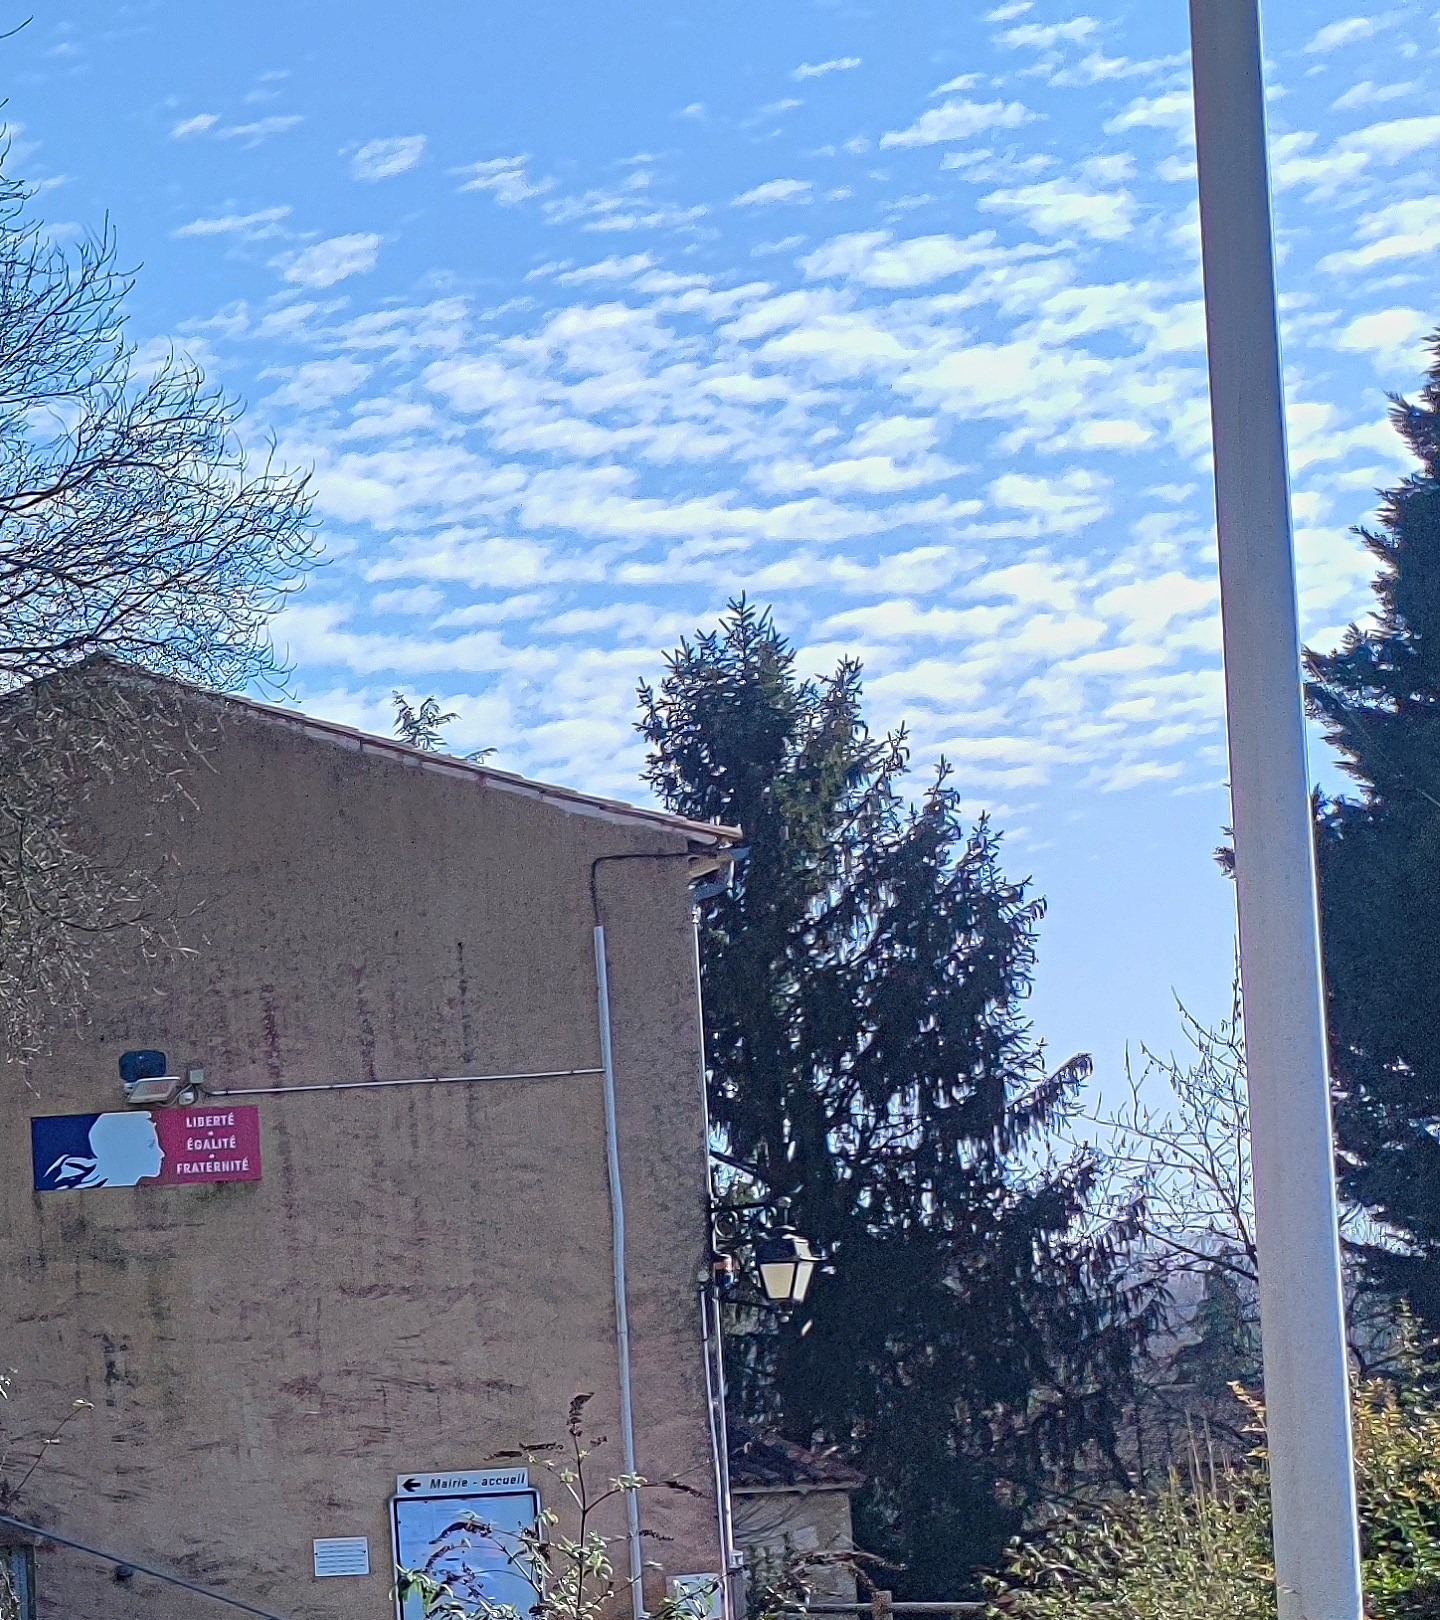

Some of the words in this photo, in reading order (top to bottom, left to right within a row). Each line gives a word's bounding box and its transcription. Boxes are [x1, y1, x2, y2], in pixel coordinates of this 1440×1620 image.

[186, 1112, 235, 1128] LIBERTÉ
[187, 1135, 237, 1150] ÉGALITÉ
[176, 1157, 250, 1174] FRATERNITÉ
[430, 1478, 468, 1489] Mairie
[481, 1472, 525, 1486] accueil
